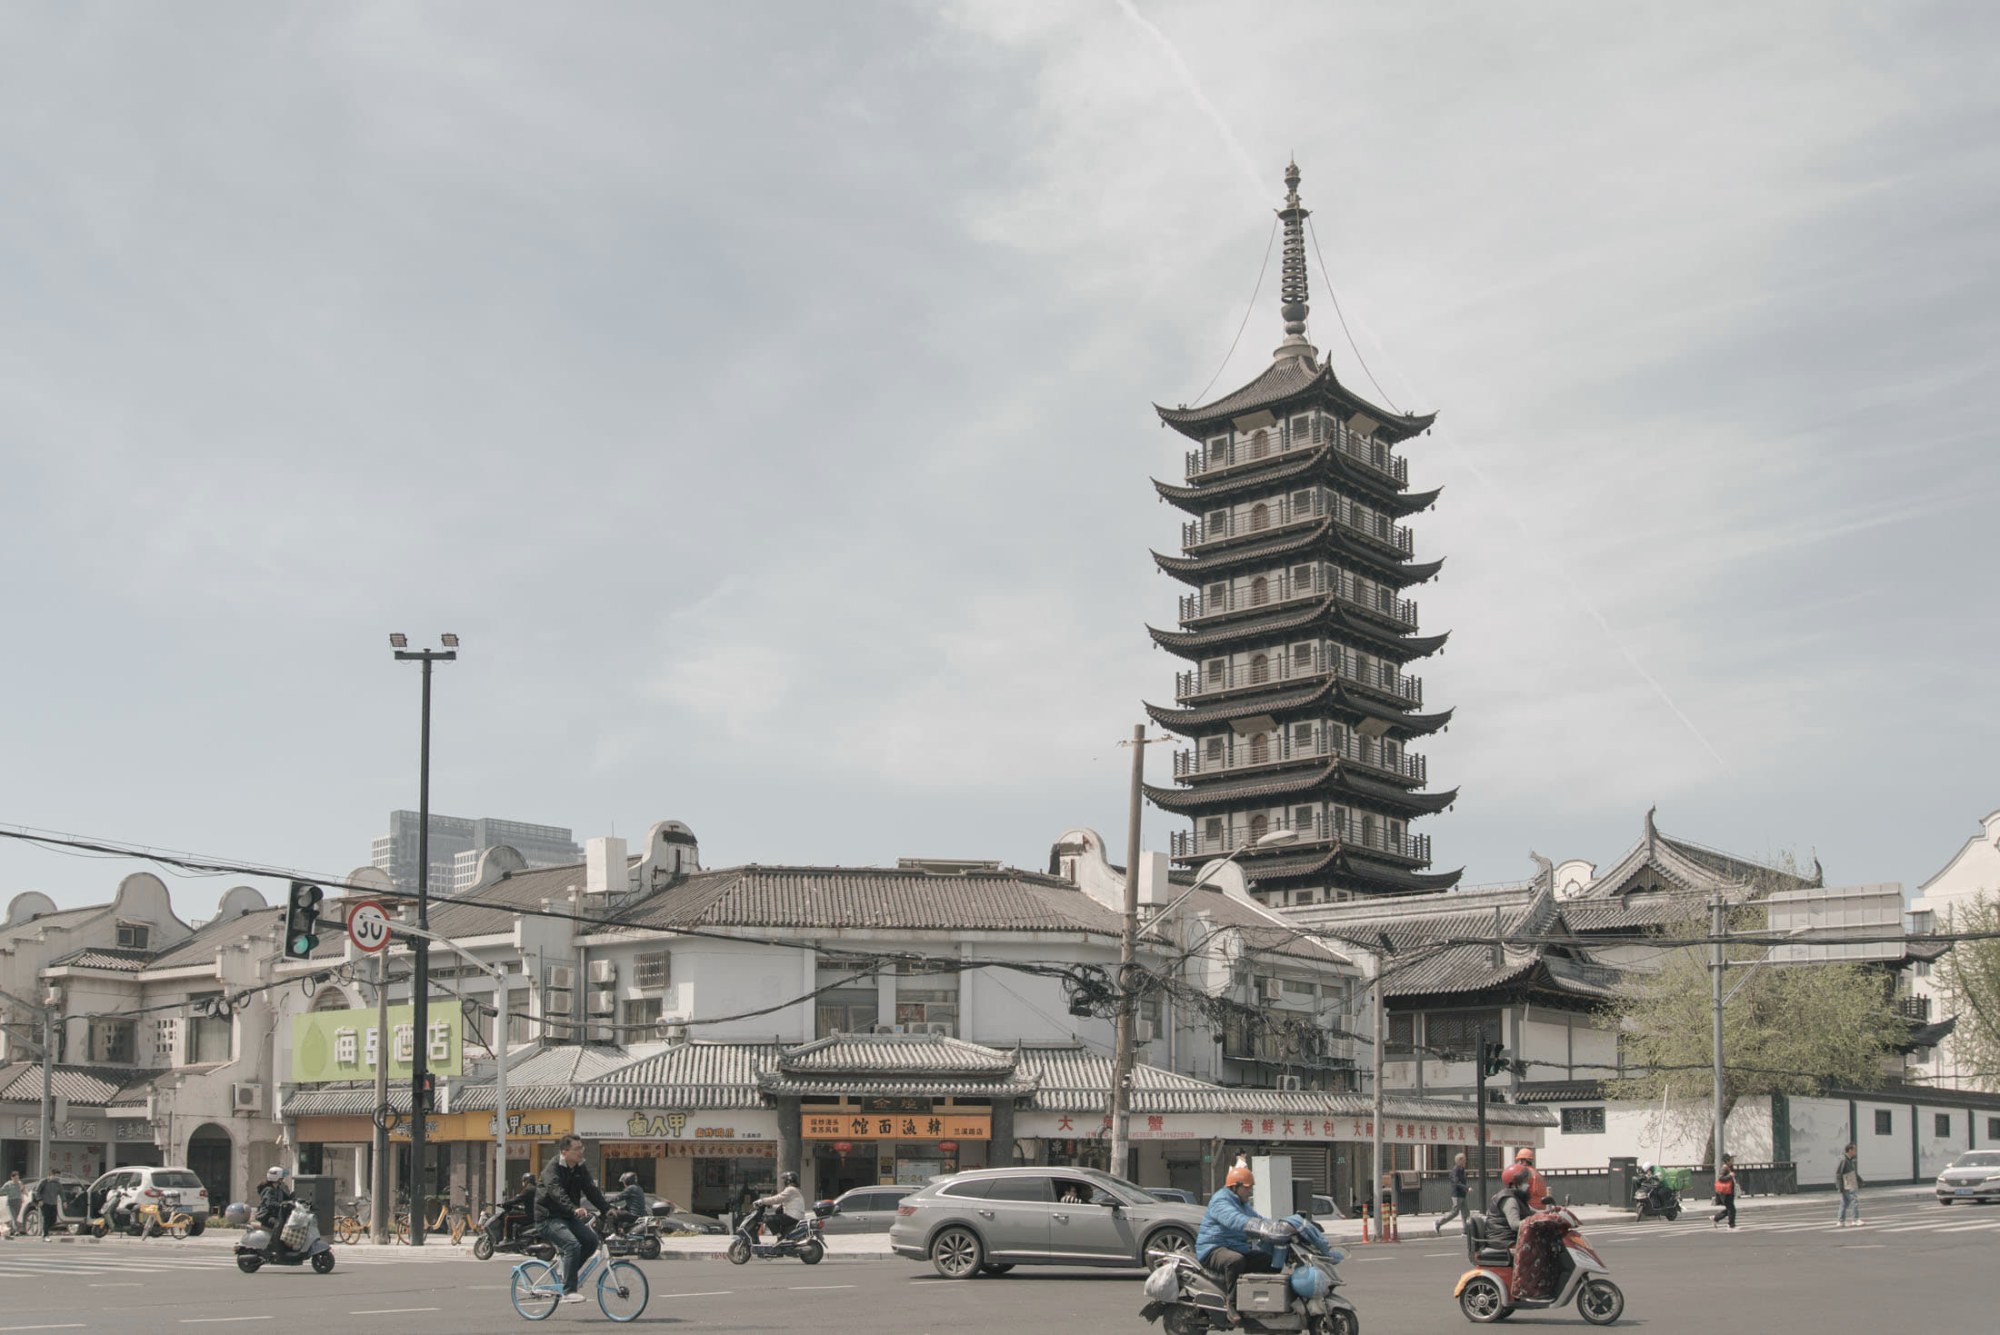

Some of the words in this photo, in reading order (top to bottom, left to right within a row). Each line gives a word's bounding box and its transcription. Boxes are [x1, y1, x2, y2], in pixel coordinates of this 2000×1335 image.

[357, 912, 383, 941] 30
[1240, 1118, 1336, 1138] 海鲜大礼包
[1353, 1120, 1386, 1138] 大闸
